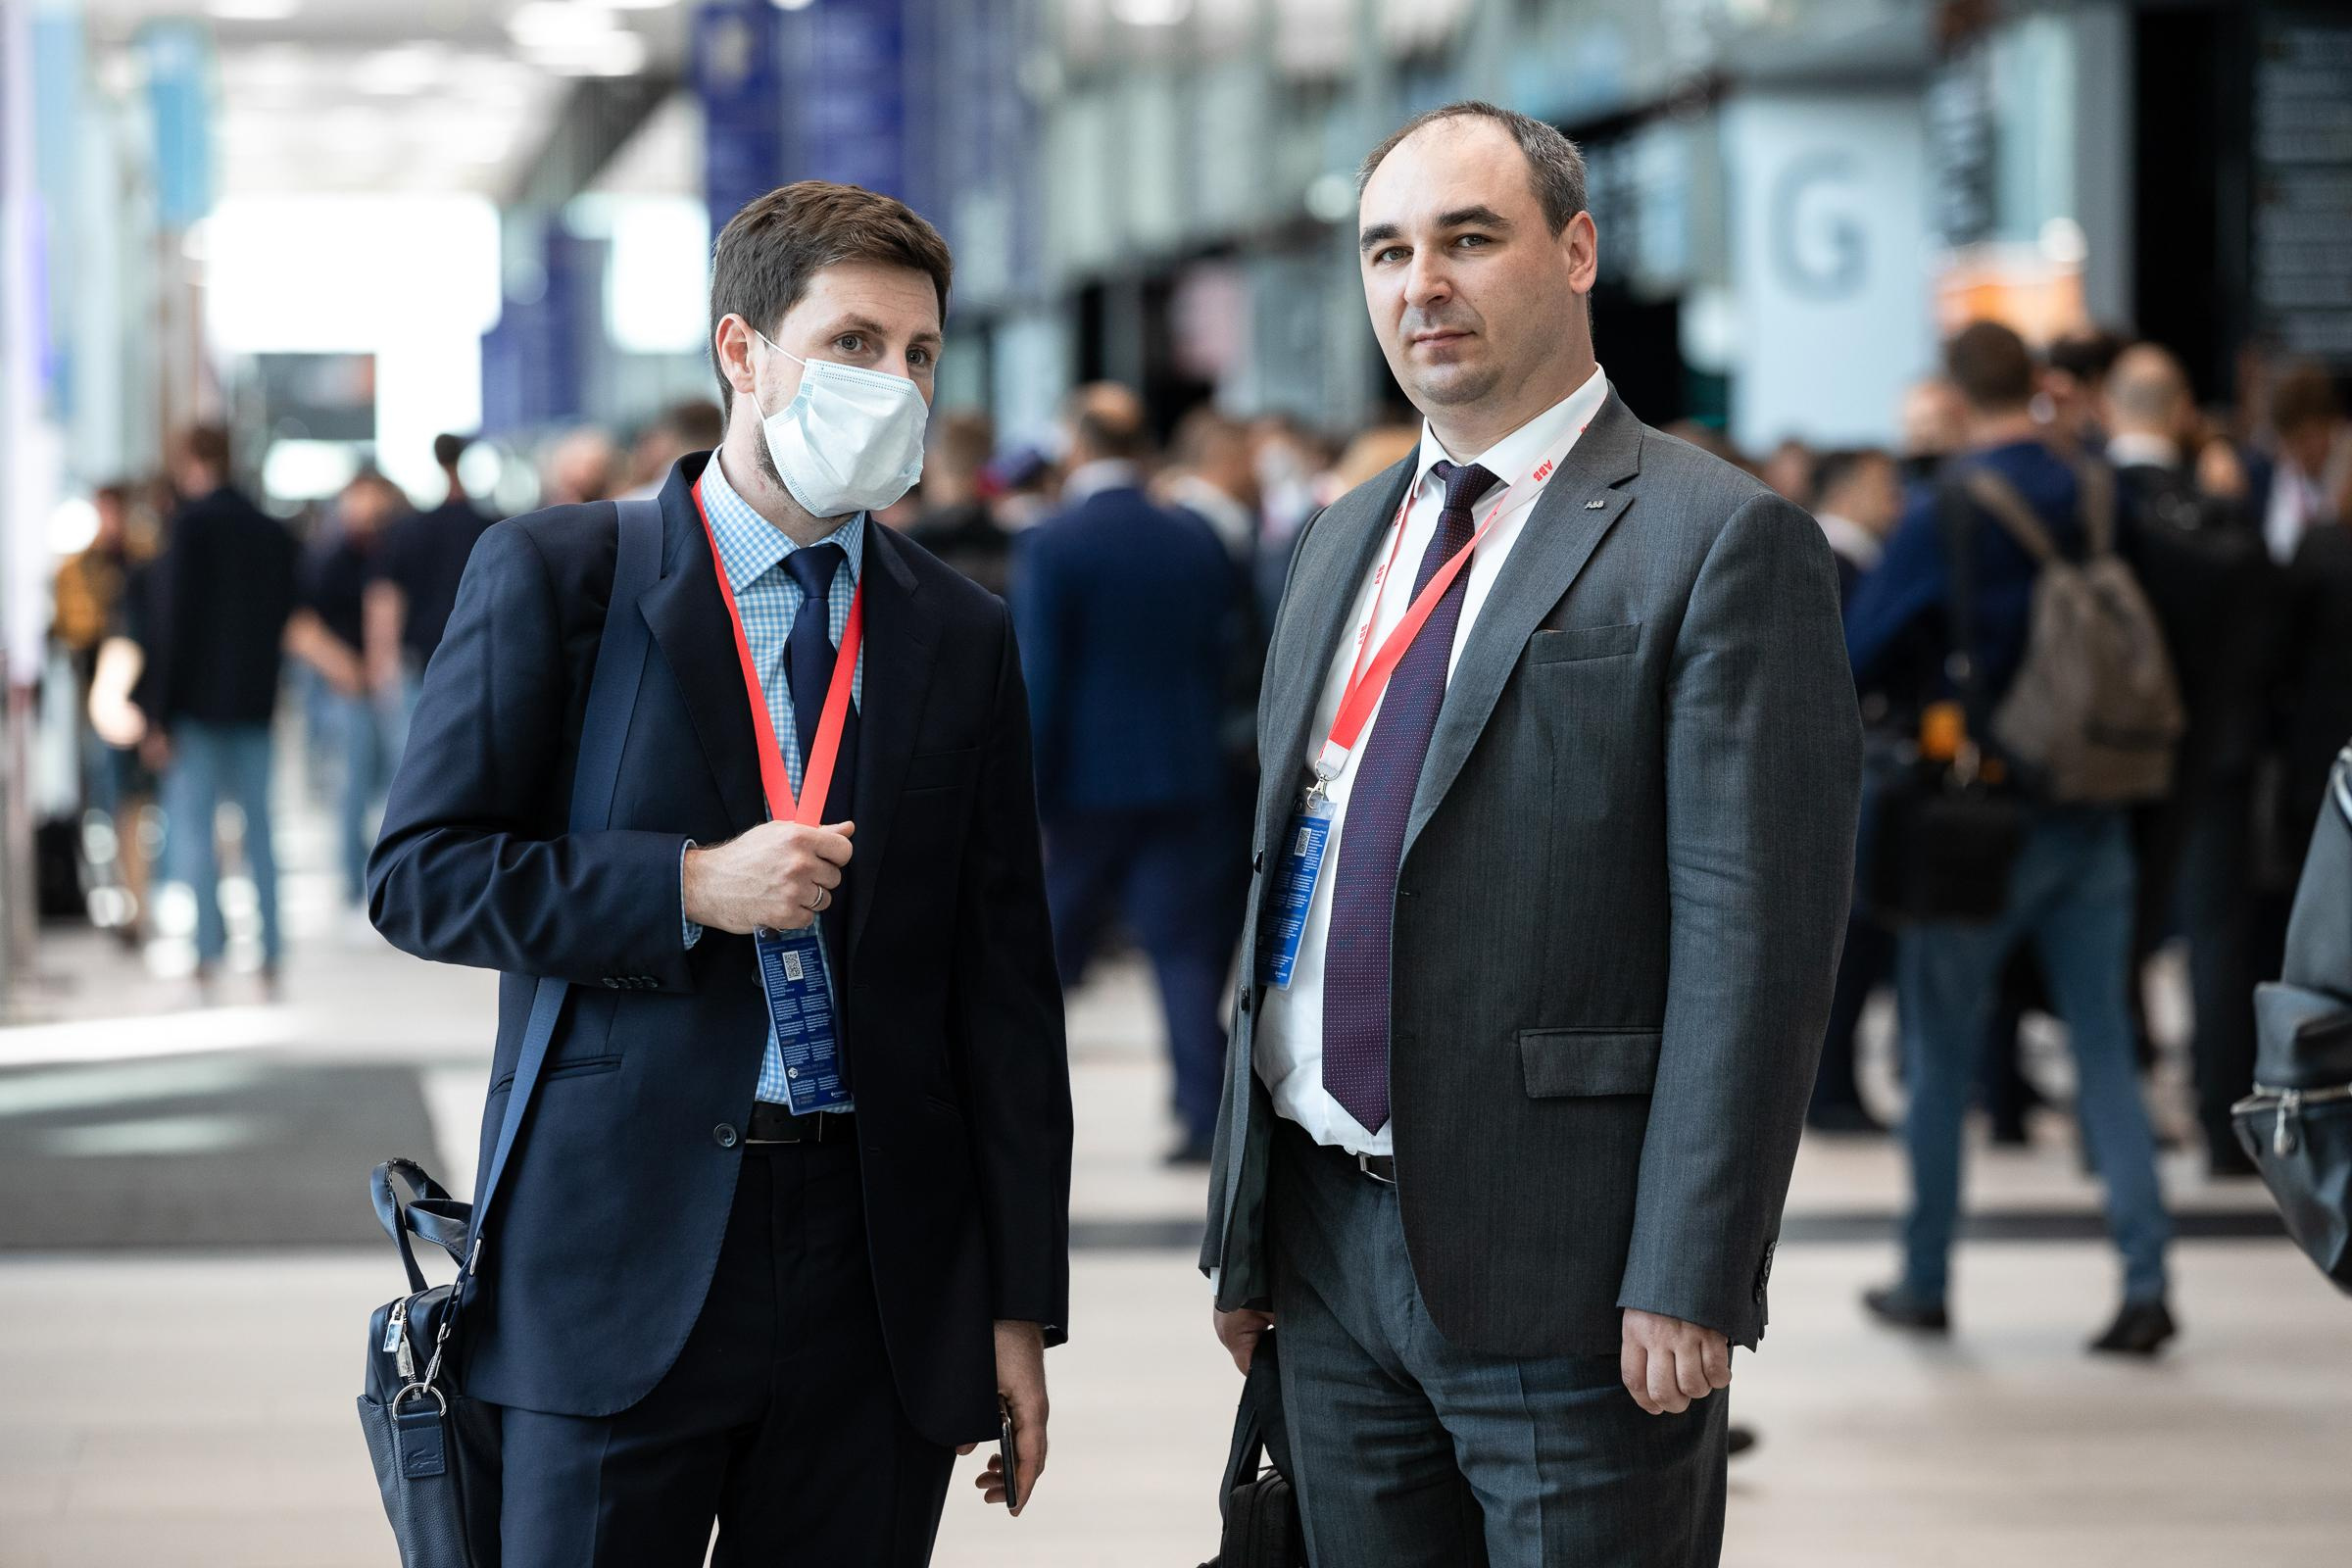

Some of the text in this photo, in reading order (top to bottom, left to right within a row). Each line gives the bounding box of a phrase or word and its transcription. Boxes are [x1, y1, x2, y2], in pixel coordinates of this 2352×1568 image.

[1533, 459, 1553, 482] ABB
[1585, 500, 1604, 510] ABB
[1394, 506, 1403, 527] ABB
[1374, 564, 1386, 585] ABB
[1357, 623, 1368, 645] ABB
